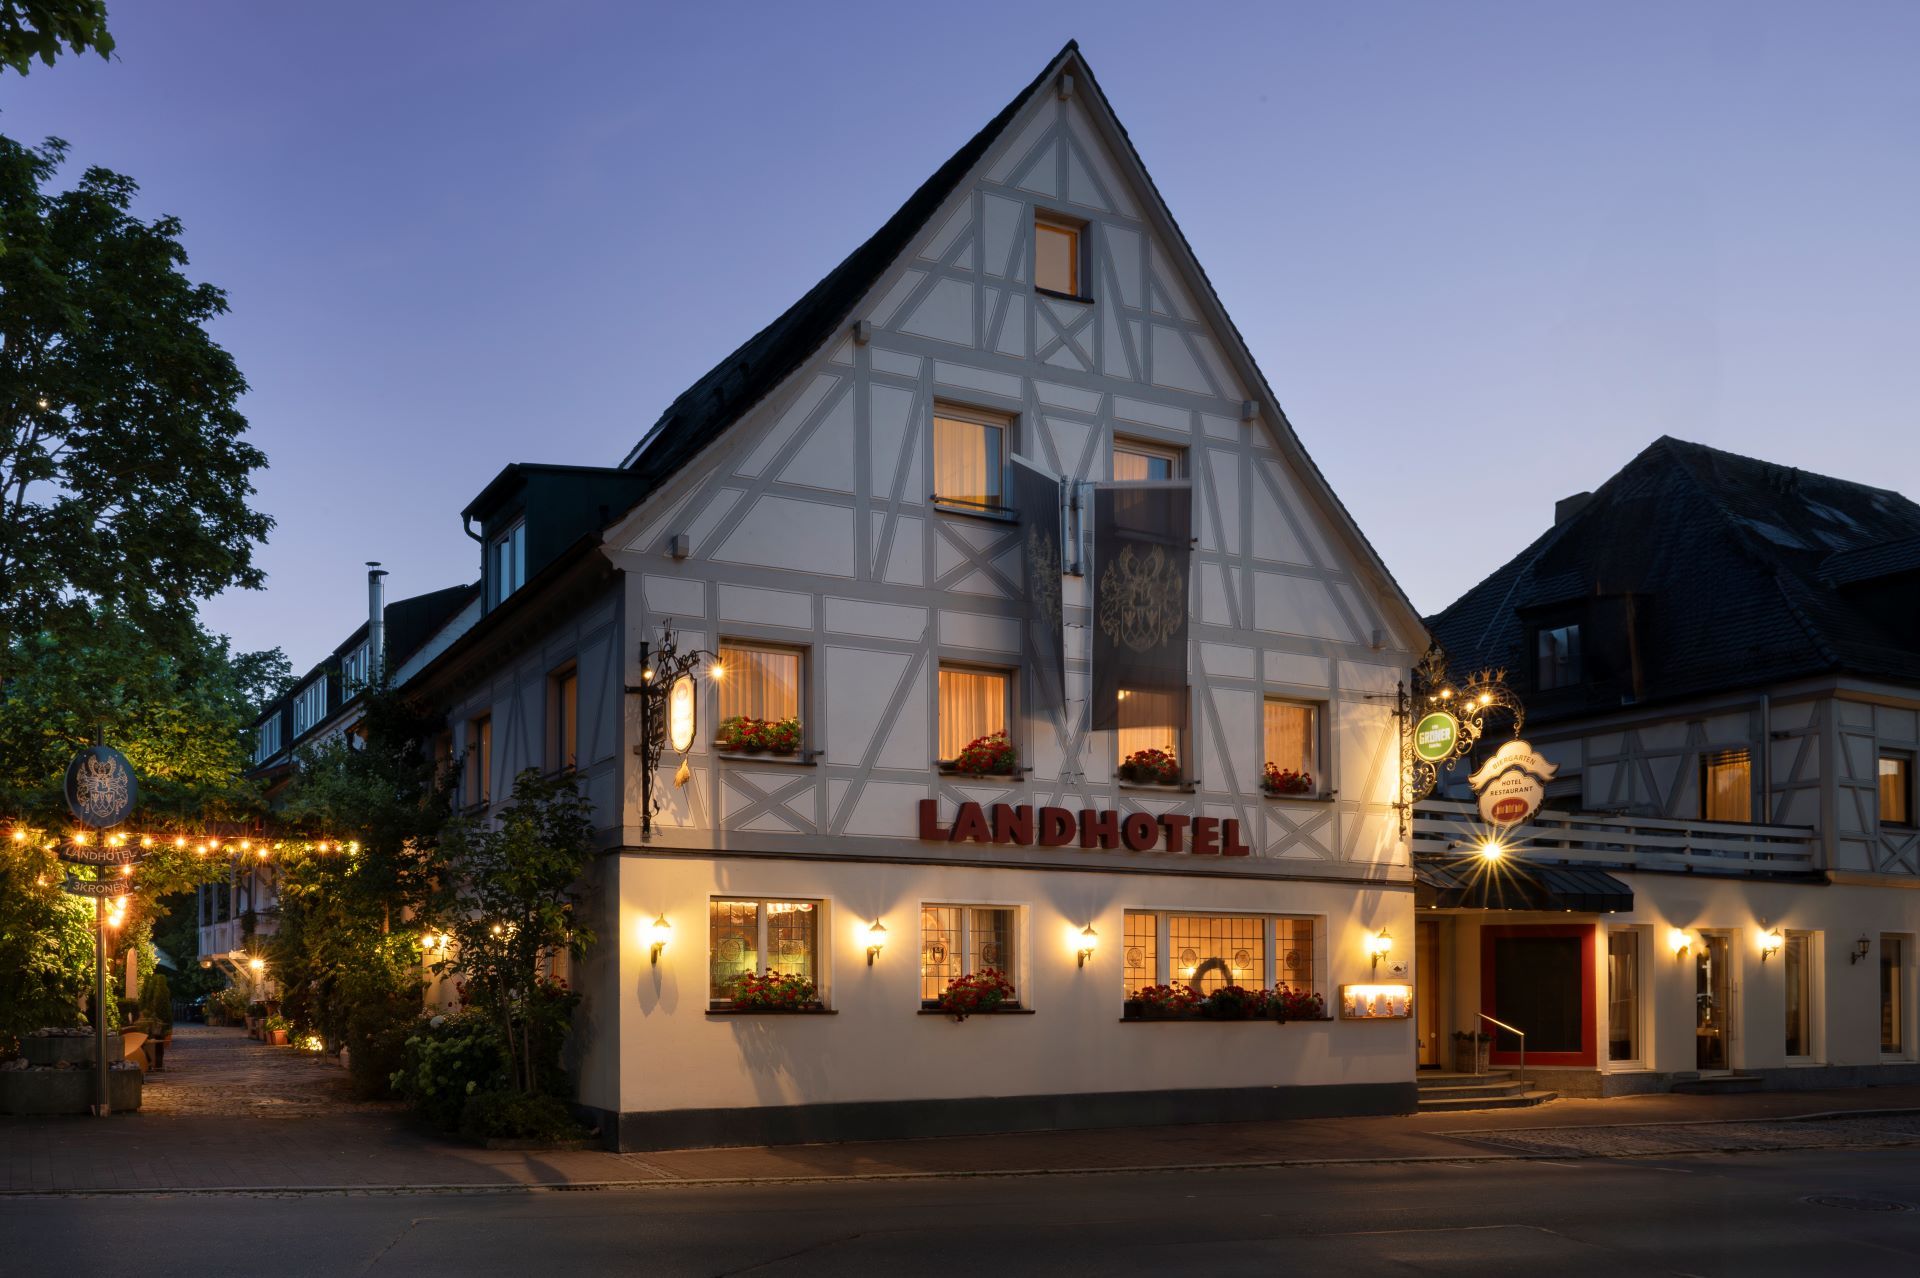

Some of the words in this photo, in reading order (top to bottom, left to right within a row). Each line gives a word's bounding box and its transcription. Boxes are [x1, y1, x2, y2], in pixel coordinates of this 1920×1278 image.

[1492, 755, 1537, 770] BIERGARTEN
[1501, 778, 1522, 787] HOTEL
[1490, 786, 1534, 796] RESTAURANT
[919, 799, 1250, 857] LANDHOTEL
[65, 847, 136, 861] LANDHOTEL
